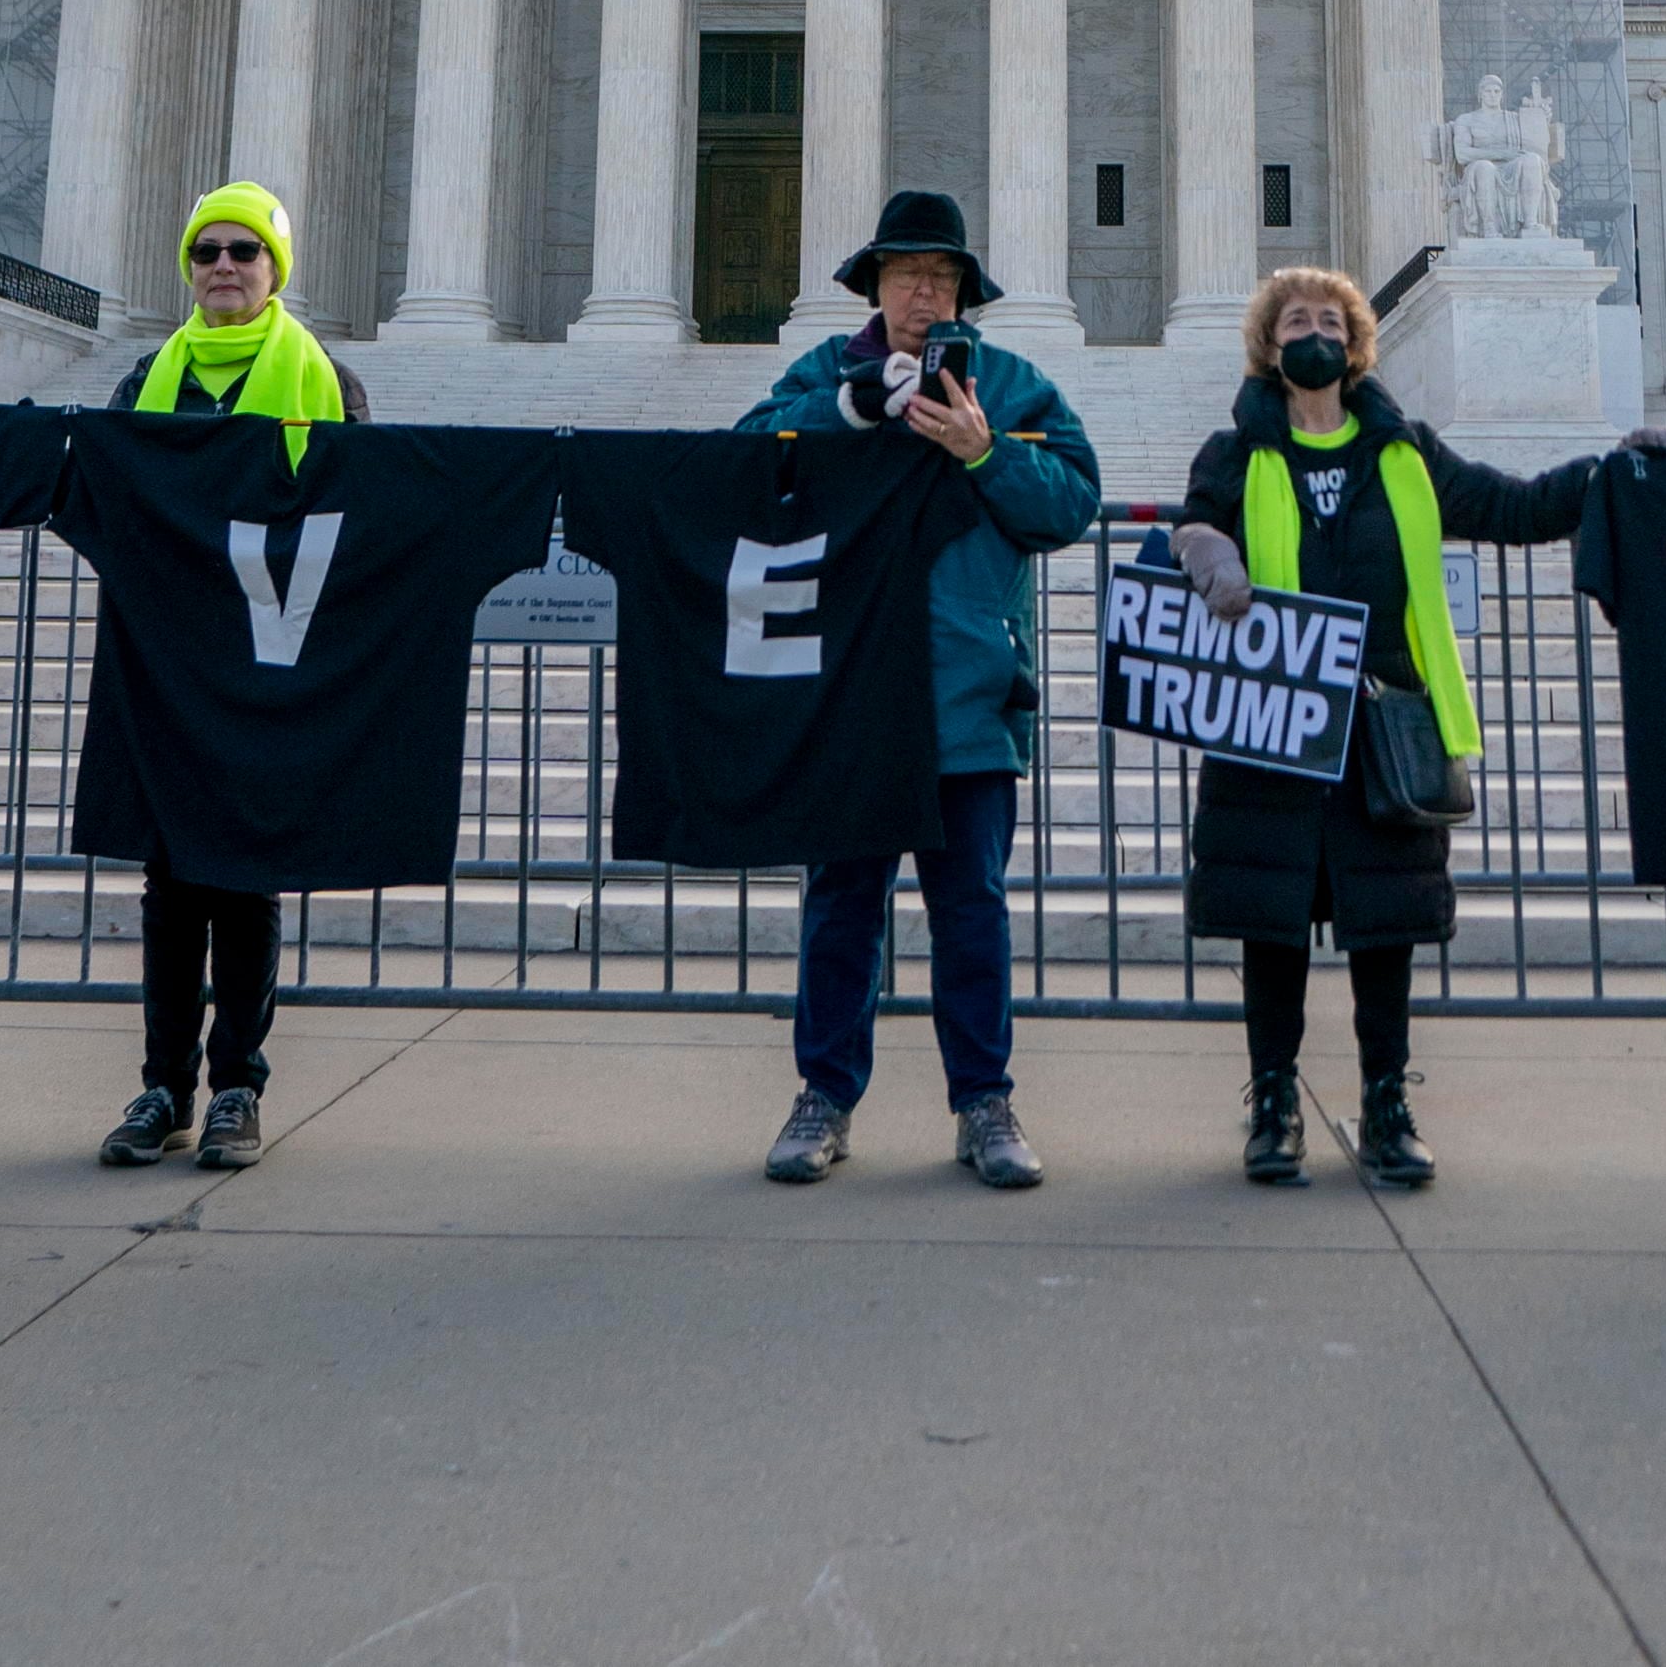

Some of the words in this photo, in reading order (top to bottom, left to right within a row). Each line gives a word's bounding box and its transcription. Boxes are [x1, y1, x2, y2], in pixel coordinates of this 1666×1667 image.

[587, 597, 613, 609] Court
[1107, 576, 1363, 688] REMOVE
[1119, 655, 1330, 758] TRUMP
